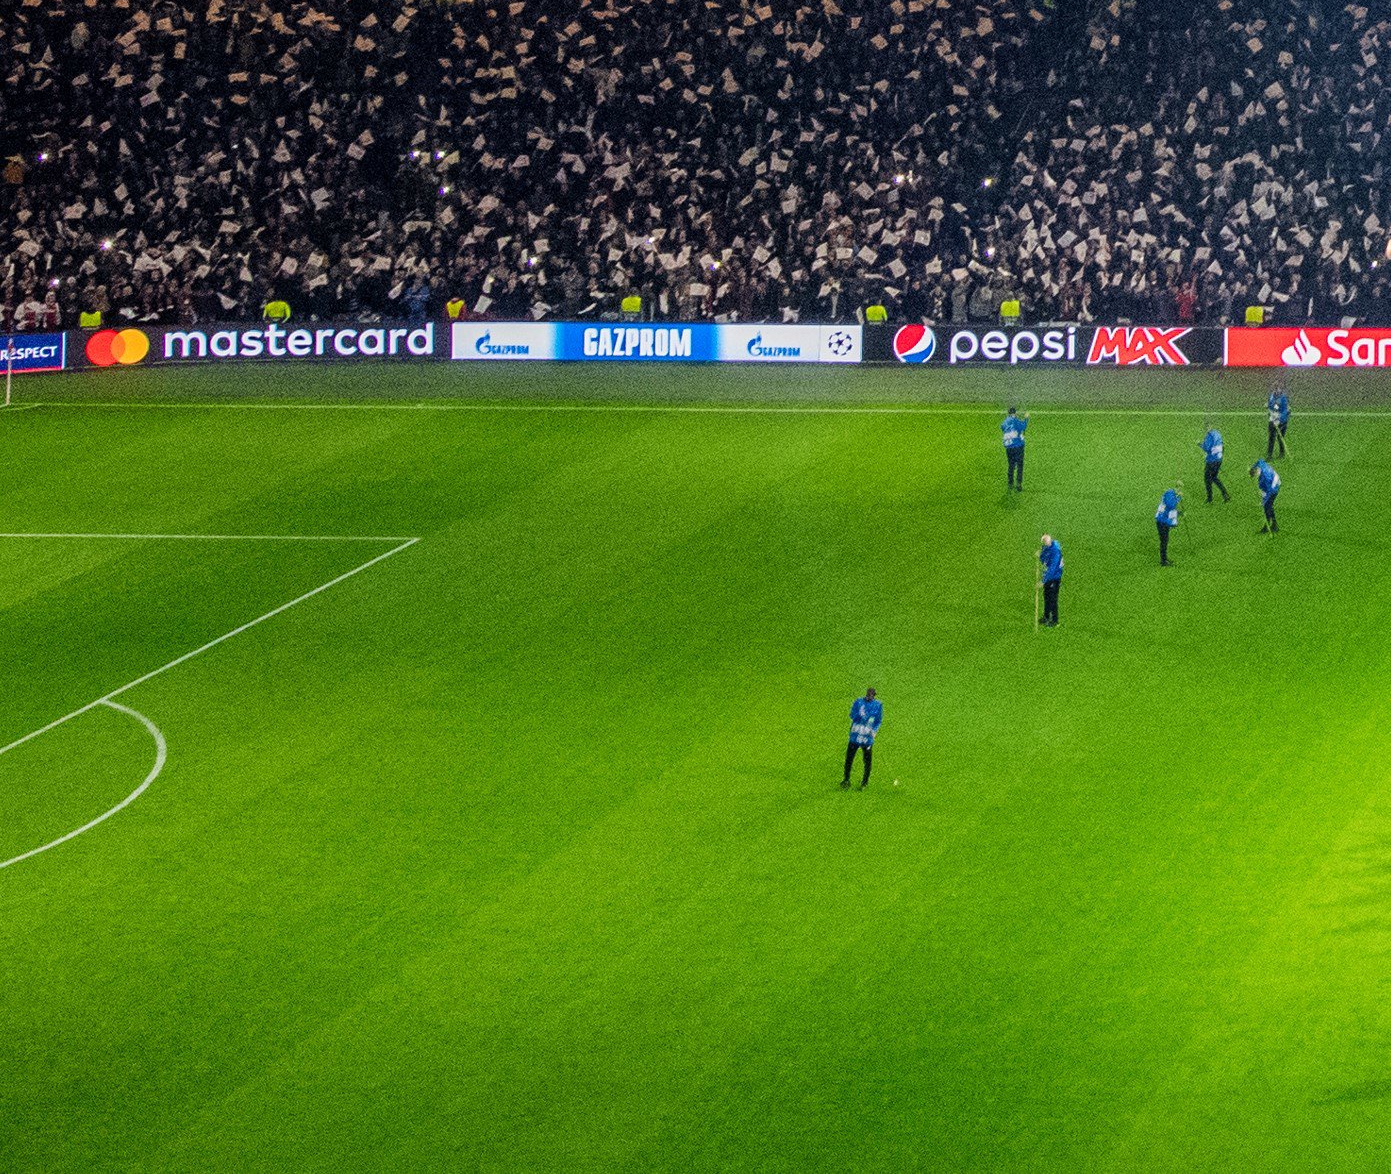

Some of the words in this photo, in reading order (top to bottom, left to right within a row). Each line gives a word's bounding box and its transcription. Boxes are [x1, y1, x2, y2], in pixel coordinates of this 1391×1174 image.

[164, 322, 434, 358] mastercard
[583, 327, 692, 357] GAZPROM
[950, 326, 1076, 364] pepsi
[1086, 327, 1193, 366] MAX
